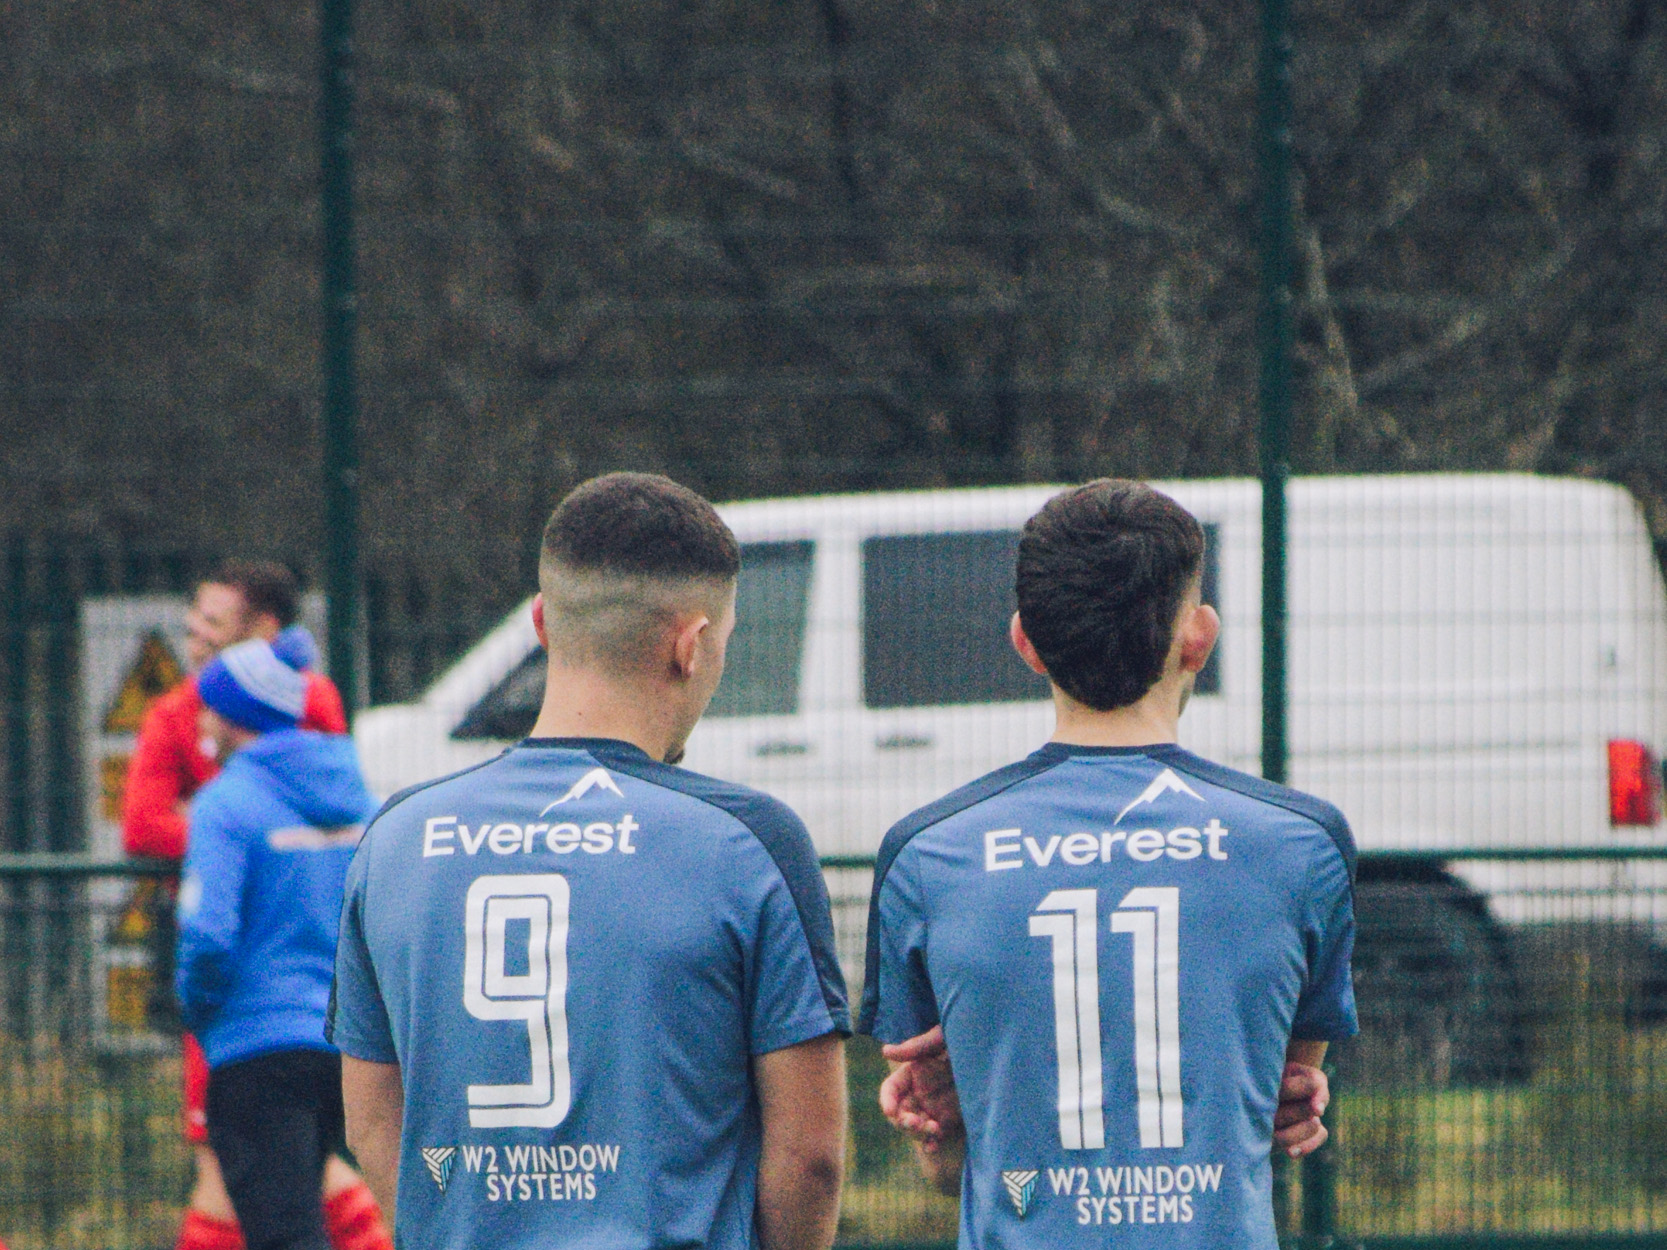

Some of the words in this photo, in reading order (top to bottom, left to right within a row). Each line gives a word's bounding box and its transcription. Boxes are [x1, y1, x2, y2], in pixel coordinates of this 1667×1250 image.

[422, 814, 639, 857] Everest
[984, 818, 1228, 872] Everest
[463, 873, 571, 1128] 9
[1028, 887, 1184, 1149] 11
[462, 1145, 499, 1173] W2
[504, 1144, 620, 1173] WINDOW
[487, 1173, 596, 1201] SYSTEMS
[1048, 1167, 1089, 1195] W2
[1096, 1164, 1223, 1194] WINDOW
[1077, 1195, 1194, 1224] SYSTEMS
